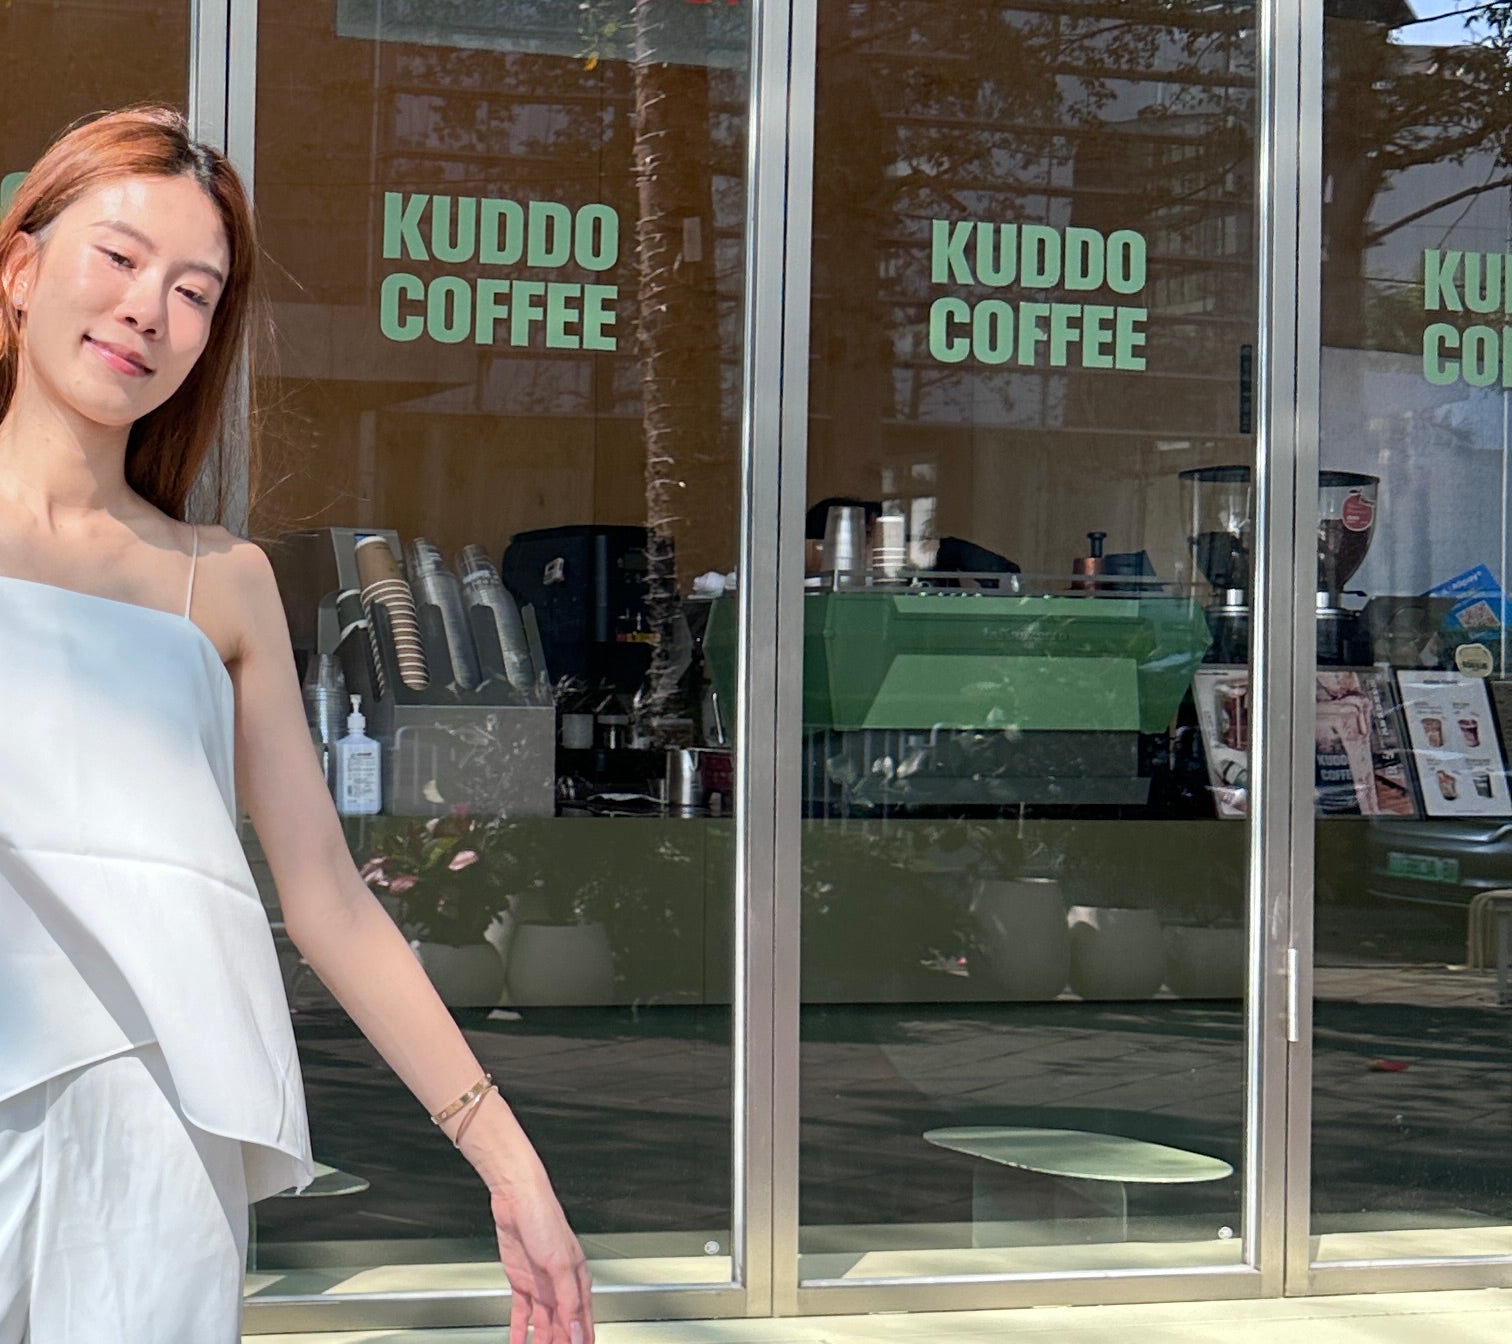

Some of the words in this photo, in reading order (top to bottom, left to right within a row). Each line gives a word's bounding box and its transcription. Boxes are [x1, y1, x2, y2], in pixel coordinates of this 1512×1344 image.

[383, 192, 619, 271] KUDDO
[931, 219, 1147, 294] KUDDO
[380, 273, 618, 351] COFFEE
[1424, 248, 1512, 314] KU
[928, 298, 1148, 371] COFFEE
[1422, 322, 1512, 388] CO
